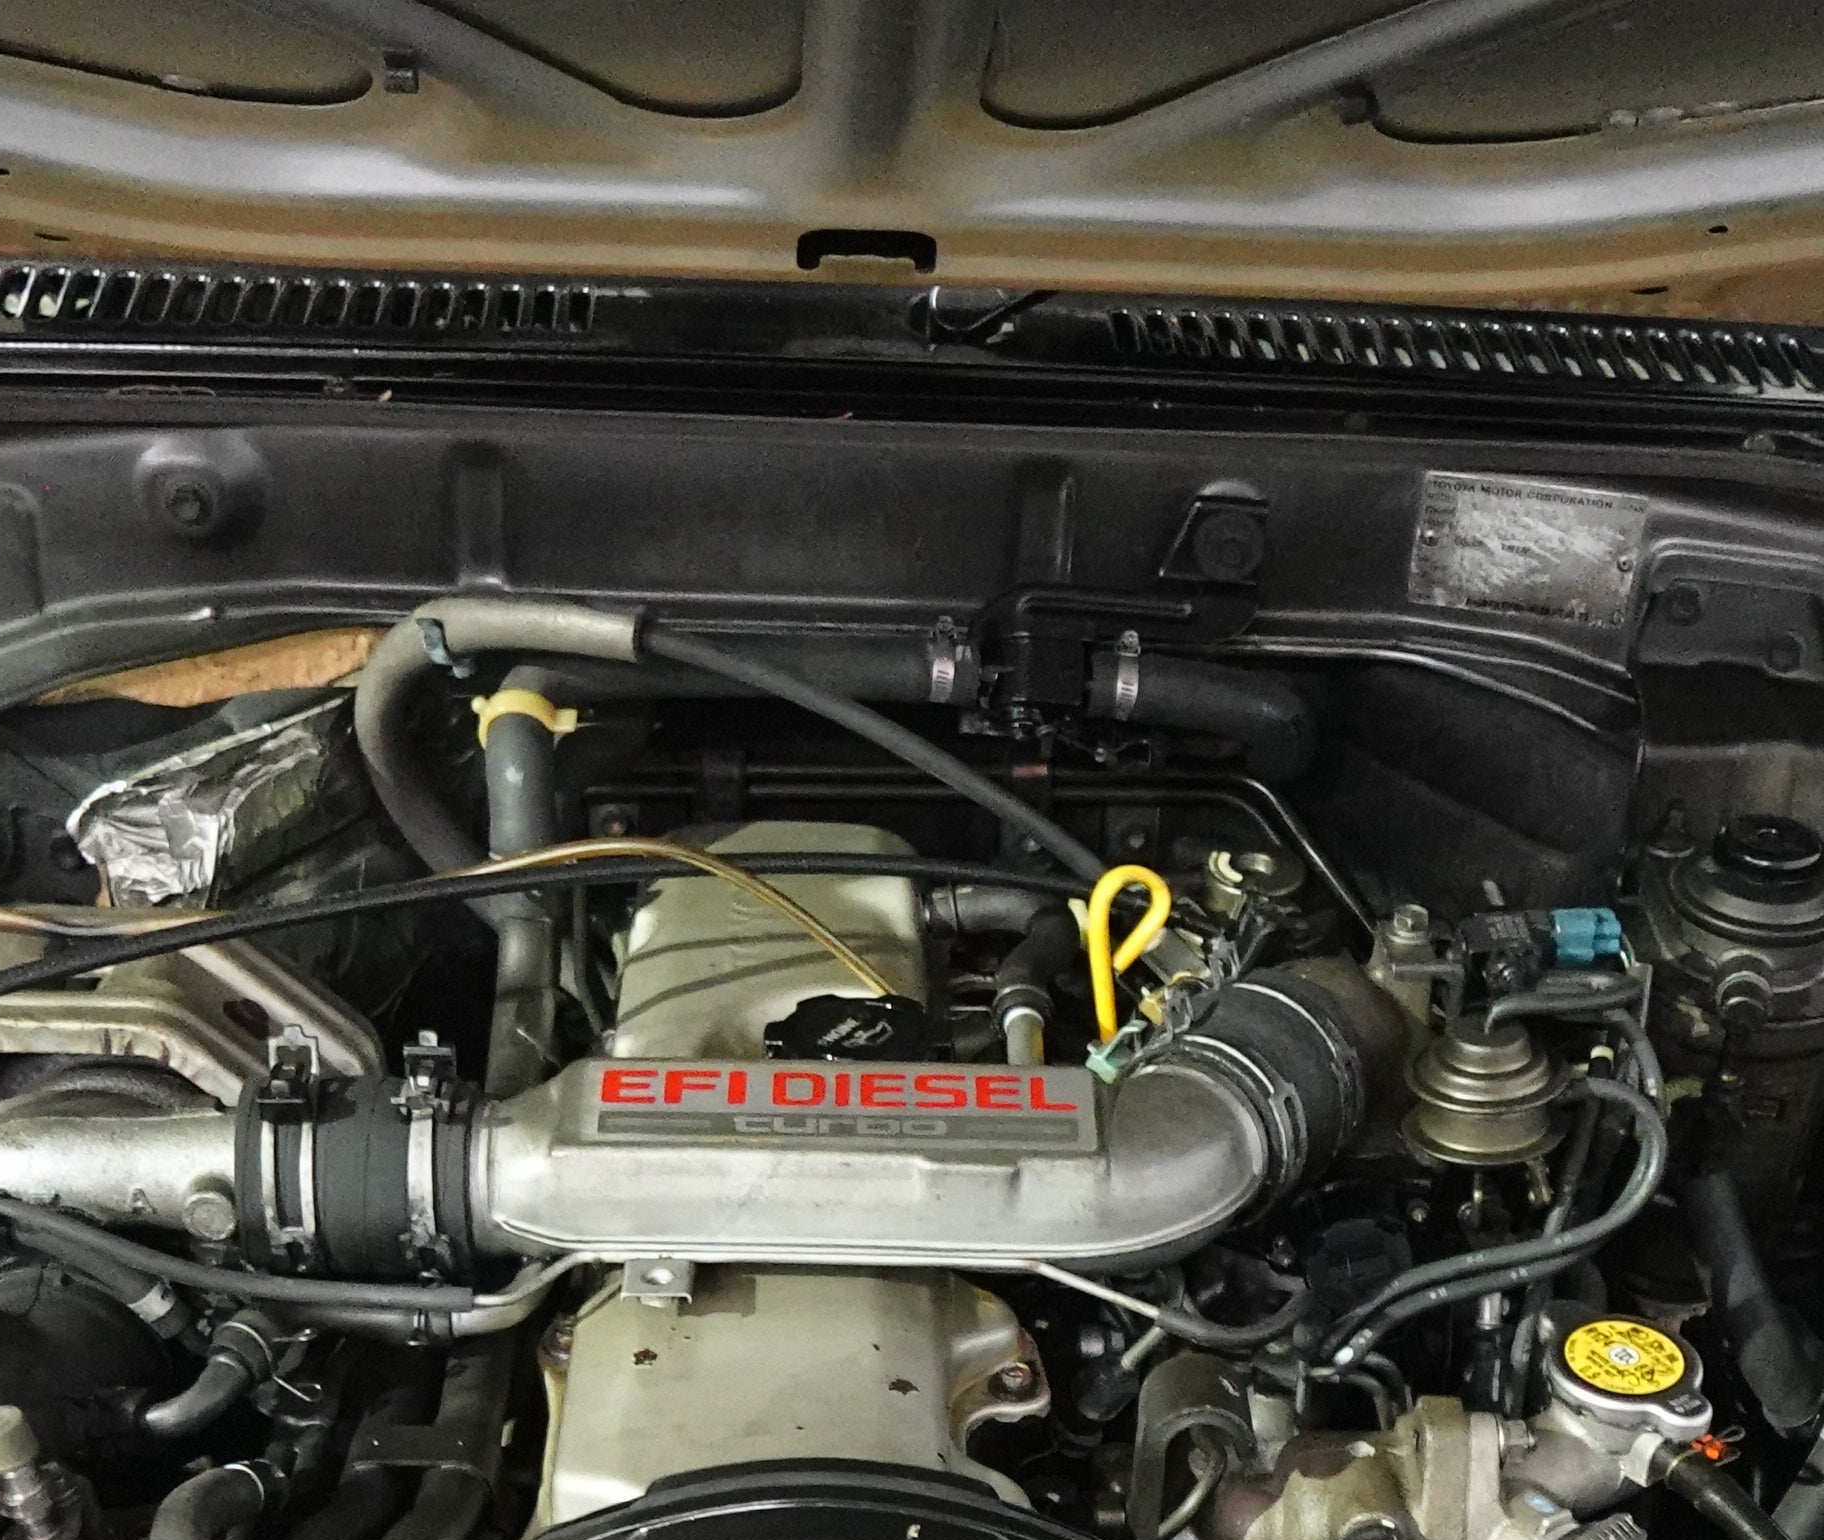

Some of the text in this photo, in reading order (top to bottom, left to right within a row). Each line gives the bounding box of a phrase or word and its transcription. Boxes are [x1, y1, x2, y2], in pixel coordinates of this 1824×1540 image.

[1479, 484, 1523, 499] MOTOR
[1526, 490, 1614, 510] CORPORATION
[601, 1068, 1078, 1113] EFI DIESEL
[732, 1113, 949, 1138] turbo
